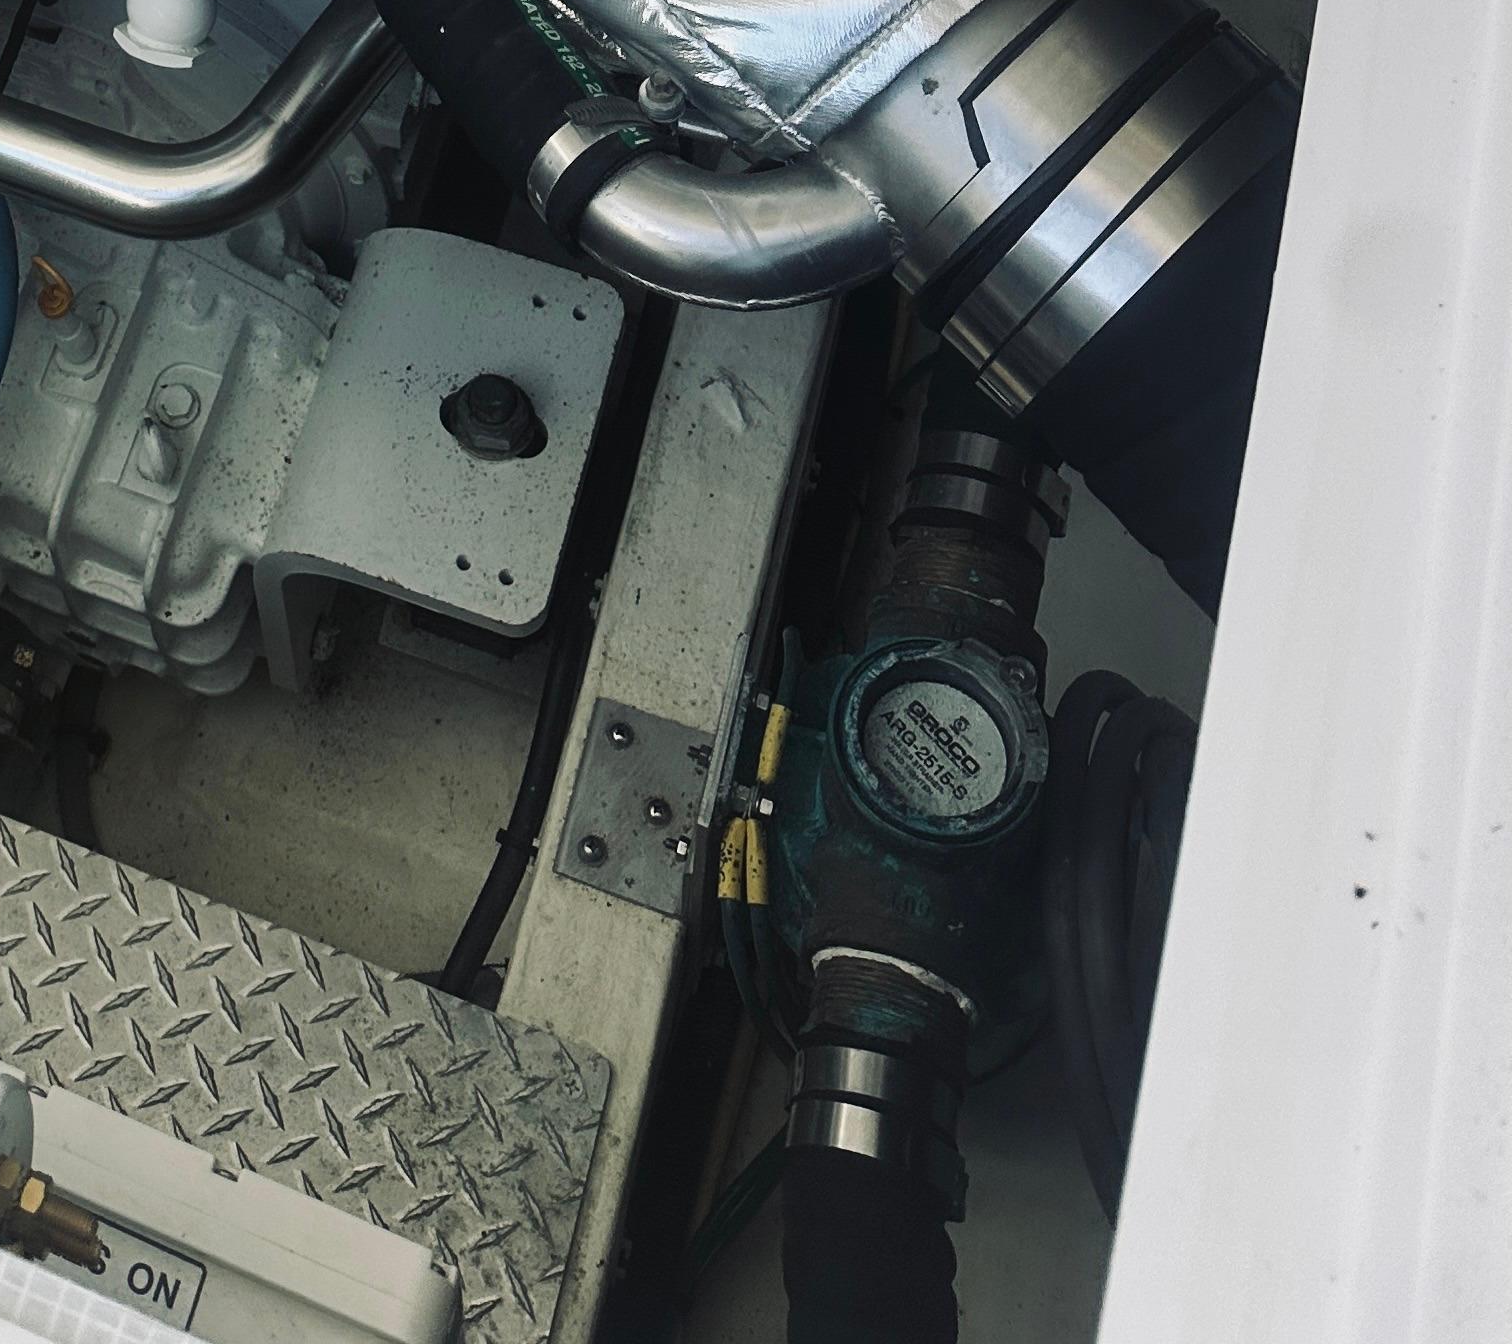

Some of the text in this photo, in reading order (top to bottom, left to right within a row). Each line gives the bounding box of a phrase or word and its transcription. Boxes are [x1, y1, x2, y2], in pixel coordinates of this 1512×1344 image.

[879, 710, 968, 801] ARG-2515-S
[906, 699, 981, 776] GROCO
[127, 1262, 182, 1309] ON
